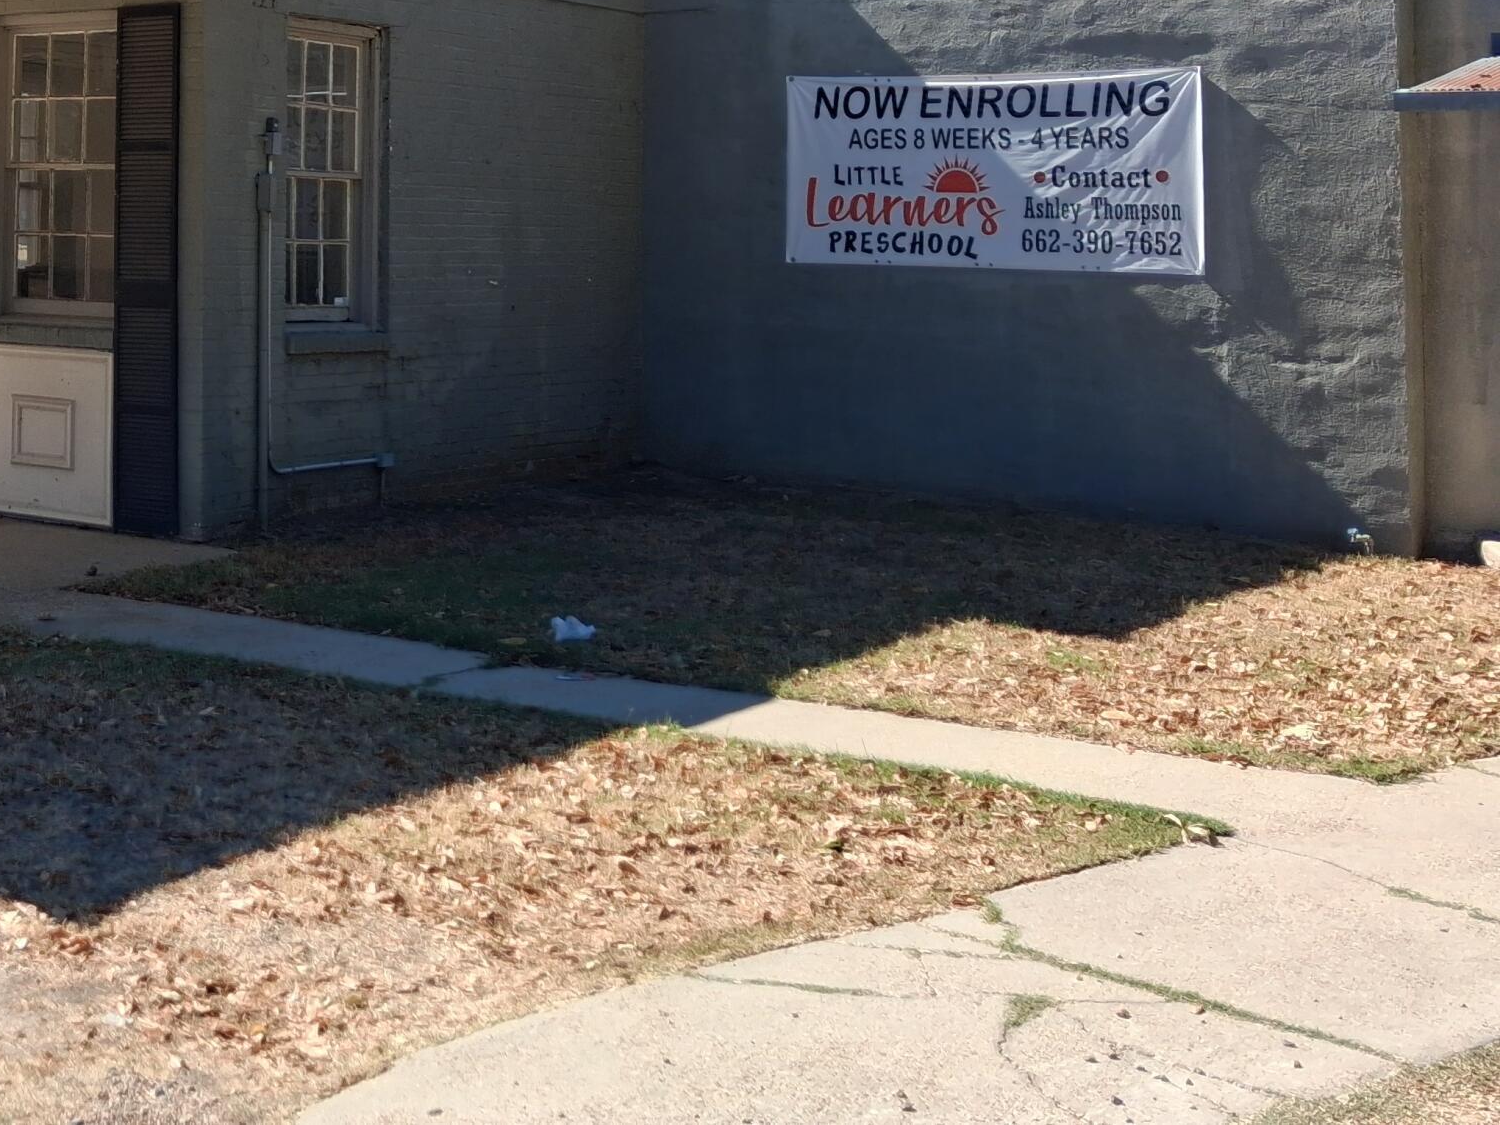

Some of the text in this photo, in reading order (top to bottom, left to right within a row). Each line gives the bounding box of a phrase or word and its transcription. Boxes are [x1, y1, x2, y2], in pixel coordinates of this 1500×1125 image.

[813, 79, 1171, 121] NOW ENROLLING
[848, 128, 908, 150] AGES
[913, 128, 926, 149] 8
[931, 127, 1012, 150] WEEKS
[1031, 127, 1043, 149] 4
[1049, 126, 1130, 150] YEARS
[833, 163, 904, 187] LITTLE
[1051, 165, 1152, 189] Contact
[805, 177, 1005, 236] Learners
[1023, 197, 1182, 226] Ashley Thompson
[828, 231, 980, 260] PRESCHOOL
[1021, 229, 1182, 257] 662-390-7652
